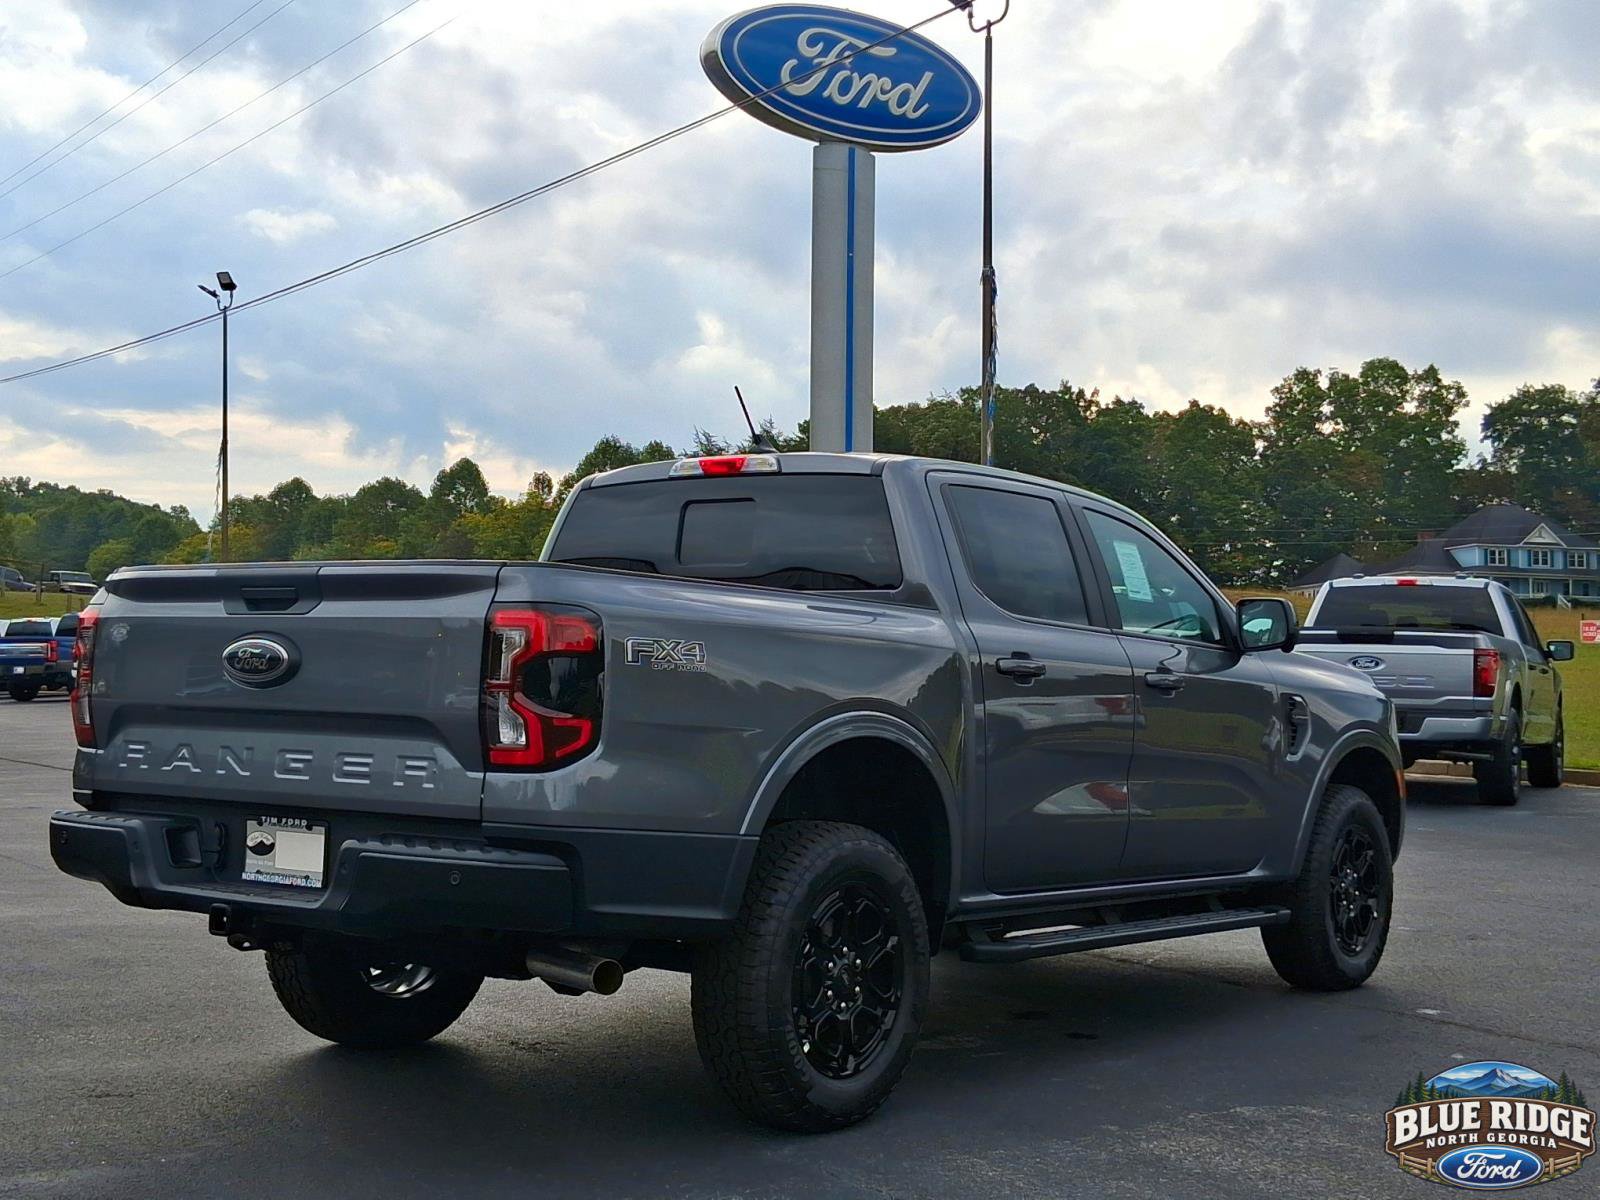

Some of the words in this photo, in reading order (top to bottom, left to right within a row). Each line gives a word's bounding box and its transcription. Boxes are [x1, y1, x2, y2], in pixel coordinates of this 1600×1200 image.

[781, 27, 935, 119] Ford
[234, 647, 271, 670] Ford
[624, 636, 707, 665] FX4
[651, 662, 675, 671] OFF
[678, 663, 707, 673] ROAD
[118, 740, 438, 789] RANGER
[261, 816, 278, 825] TIM
[282, 818, 308, 827] FORD
